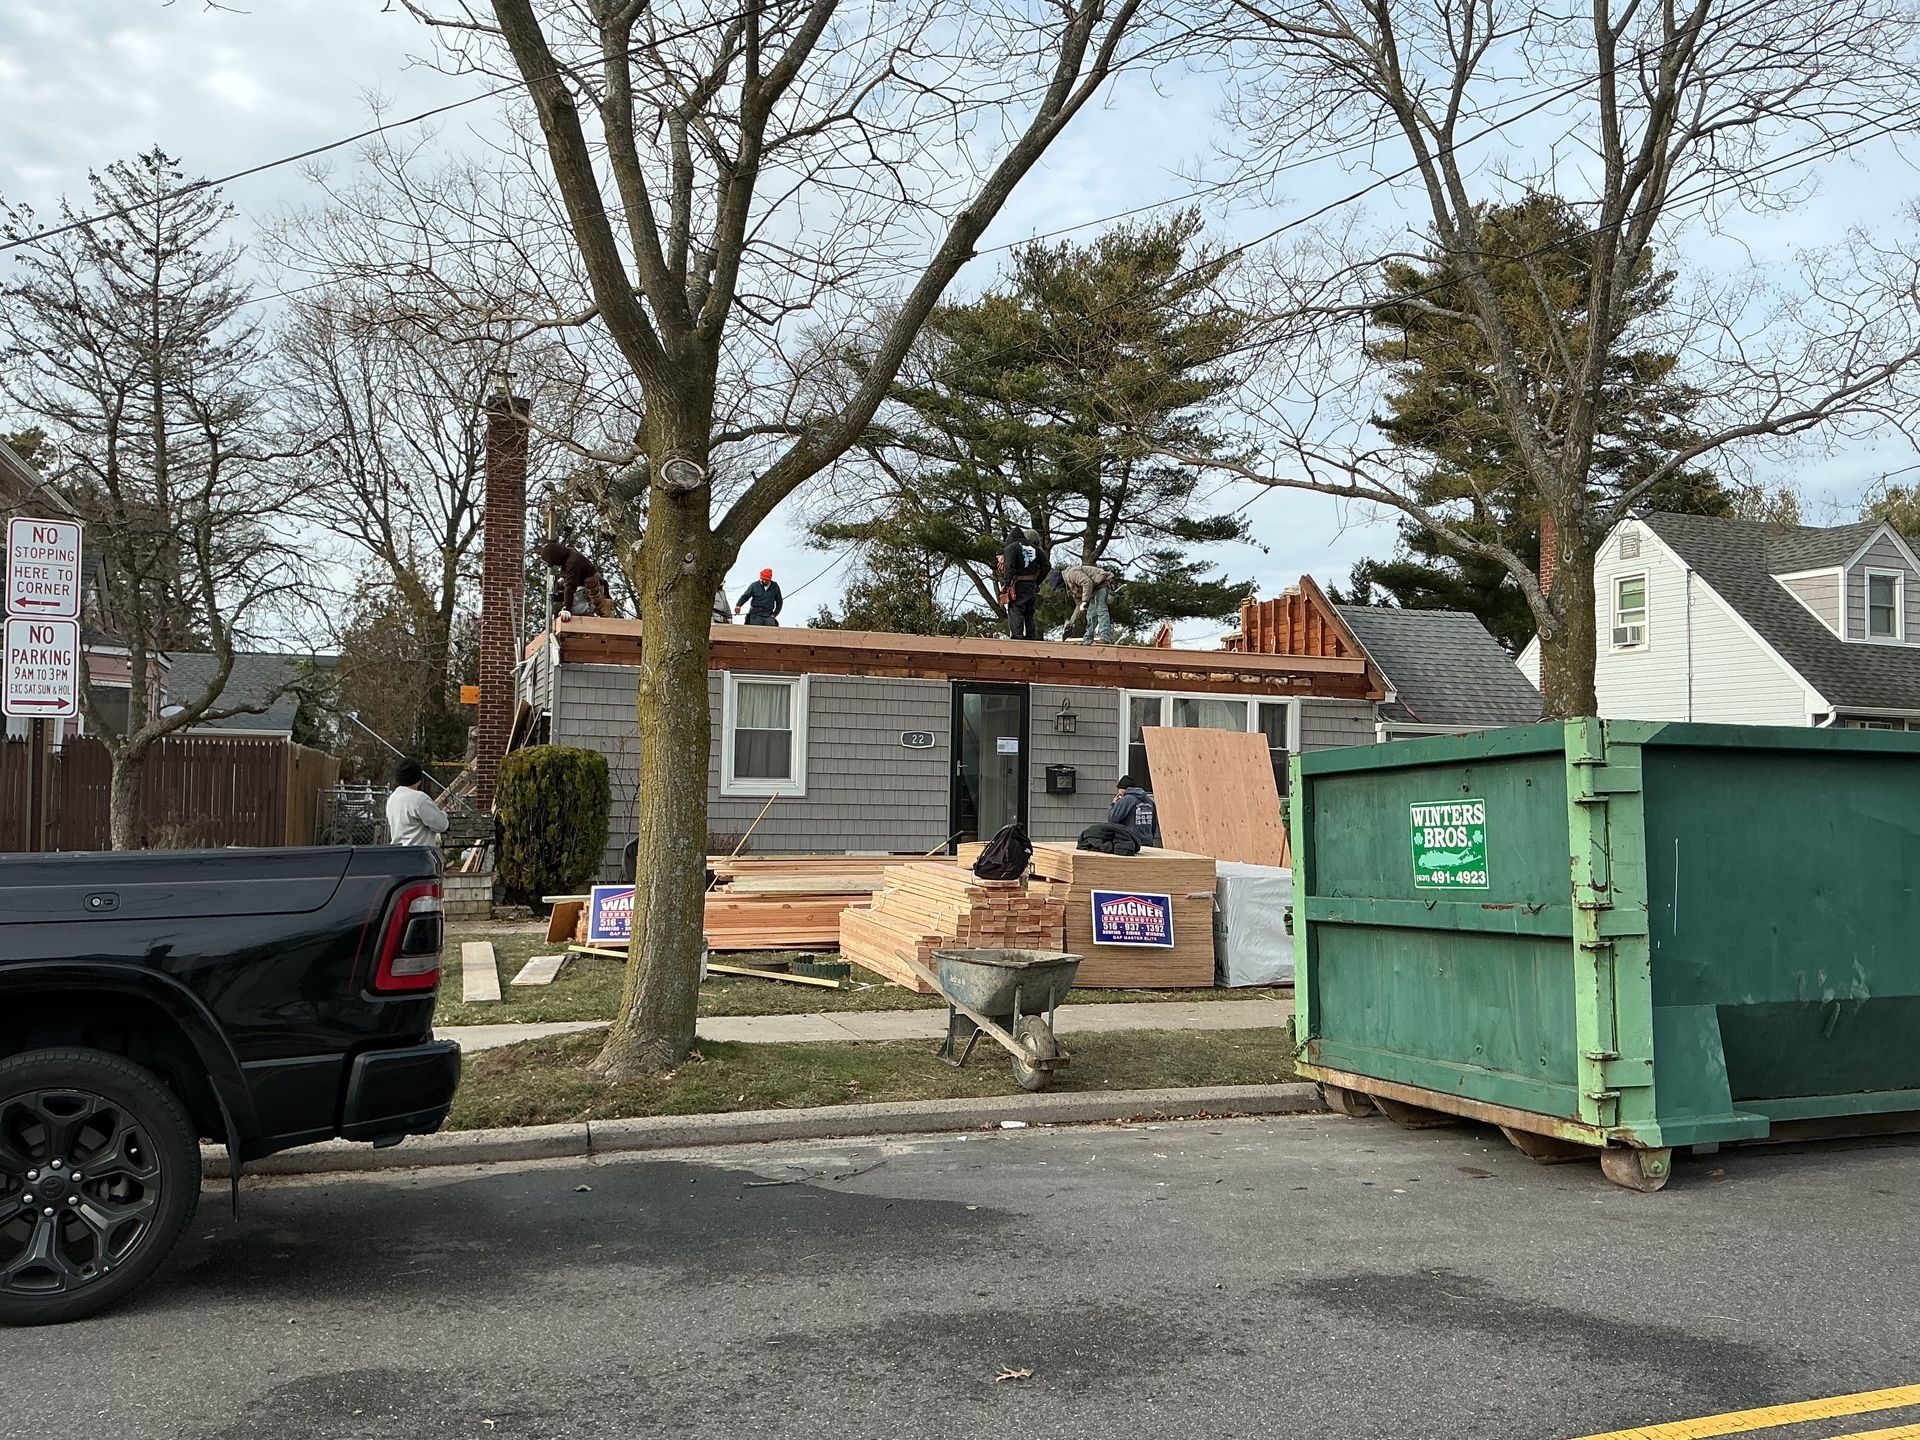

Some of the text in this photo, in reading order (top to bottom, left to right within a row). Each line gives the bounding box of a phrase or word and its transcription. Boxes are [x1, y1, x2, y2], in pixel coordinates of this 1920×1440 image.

[32, 526, 58, 545] NO
[15, 546, 74, 562] STOPPING
[14, 566, 73, 581] HERE TO
[17, 581, 70, 596] CORNER
[30, 625, 54, 644] NO
[12, 648, 71, 666] PARKING
[37, 669, 47, 680] TO
[10, 684, 23, 694] EXC
[24, 684, 36, 694] SAT
[37, 684, 51, 694] SUN
[58, 685, 71, 695] HOL
[912, 734, 925, 744] 22
[1411, 804, 1484, 826] WINTERS
[1423, 826, 1472, 848] BROS.
[1102, 901, 1164, 917] WAGNER
